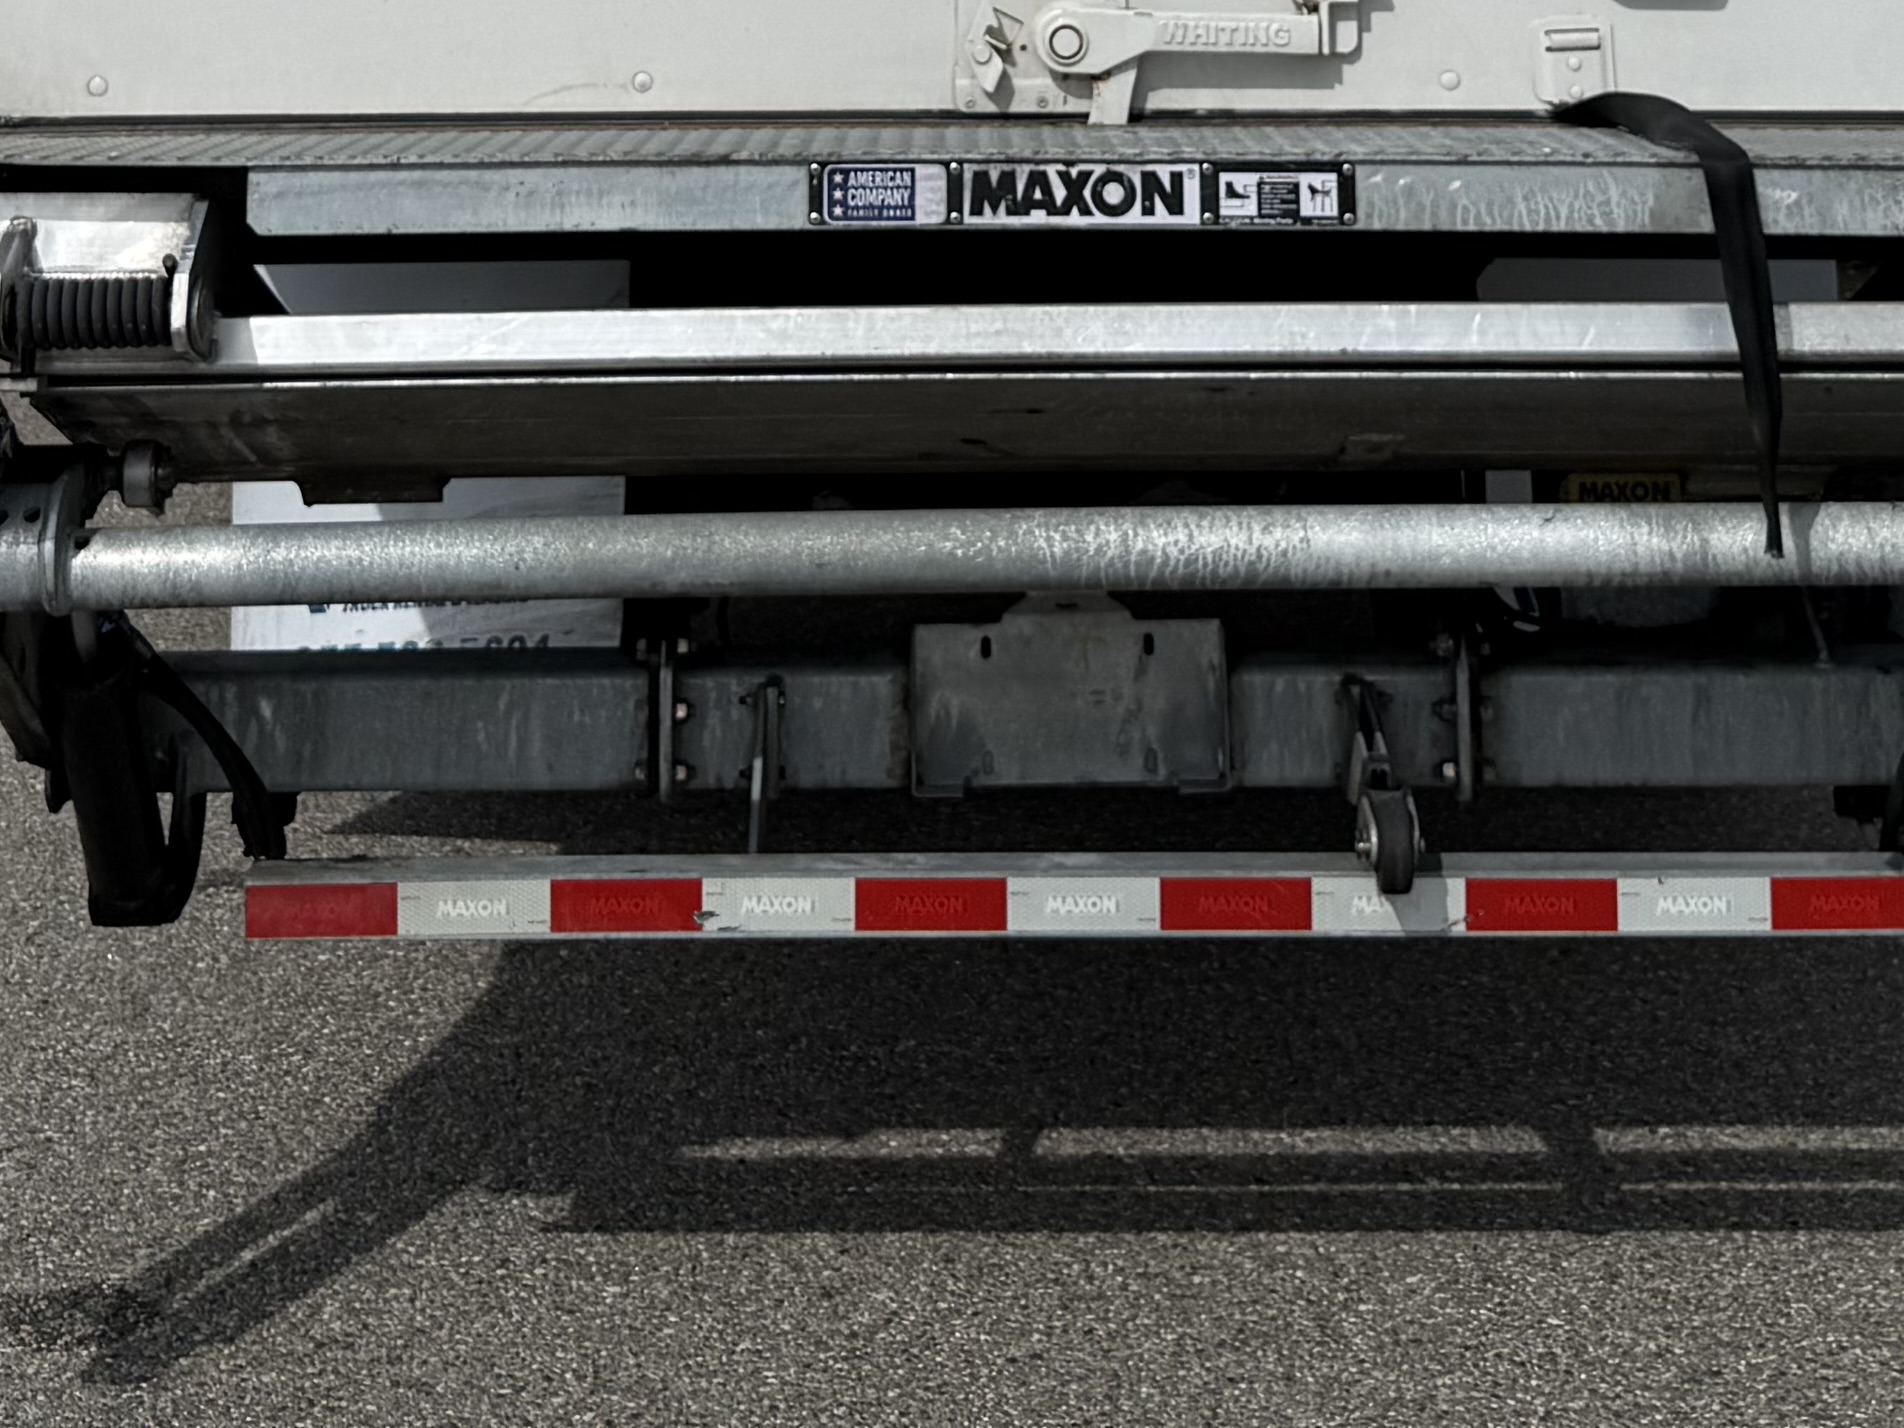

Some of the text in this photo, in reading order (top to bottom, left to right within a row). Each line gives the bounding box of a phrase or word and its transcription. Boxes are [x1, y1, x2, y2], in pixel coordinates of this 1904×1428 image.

[1159, 21, 1291, 47] WHITING
[847, 171, 912, 186] AMERICAN
[847, 188, 912, 206] COMPANY
[969, 169, 1185, 217] MAXON
[1579, 481, 1672, 502] MAXON
[437, 899, 507, 917] MAXON
[591, 897, 662, 915] MAXON
[741, 896, 812, 915] MAXON
[895, 896, 966, 914] MAXON
[1047, 896, 1117, 915] MAXON
[1198, 896, 1269, 914] MAXON
[1503, 896, 1575, 914] MAXON
[1657, 896, 1727, 915] MAXON
[1809, 895, 1880, 913] MAXON
